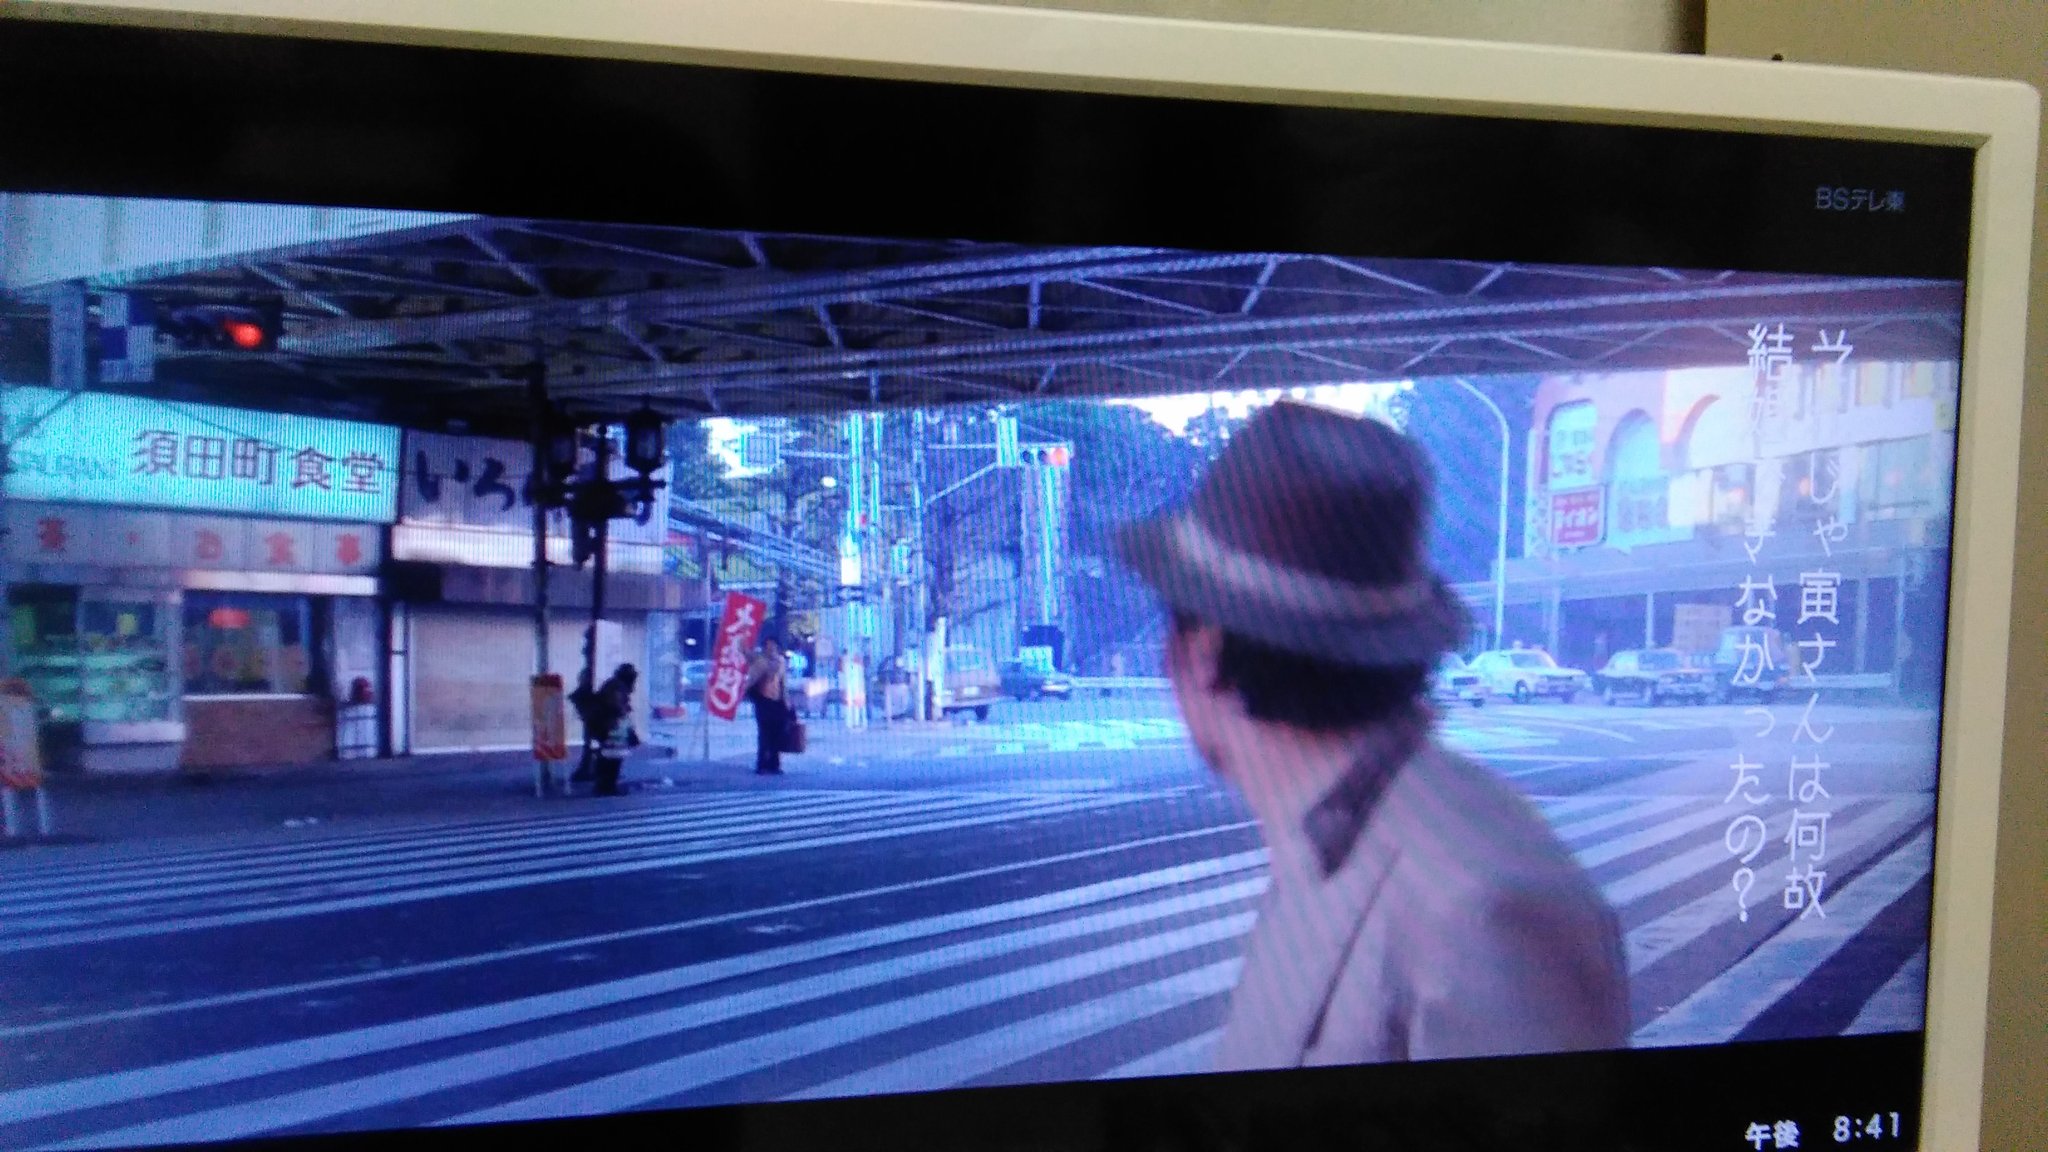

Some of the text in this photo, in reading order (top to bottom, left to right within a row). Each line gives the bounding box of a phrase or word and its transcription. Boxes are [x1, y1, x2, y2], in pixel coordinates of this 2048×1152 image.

[1815, 187, 1905, 212] BSテレ東
[132, 429, 386, 494] 須田町食堂
[1744, 1111, 1899, 1151] 午後 8:41
